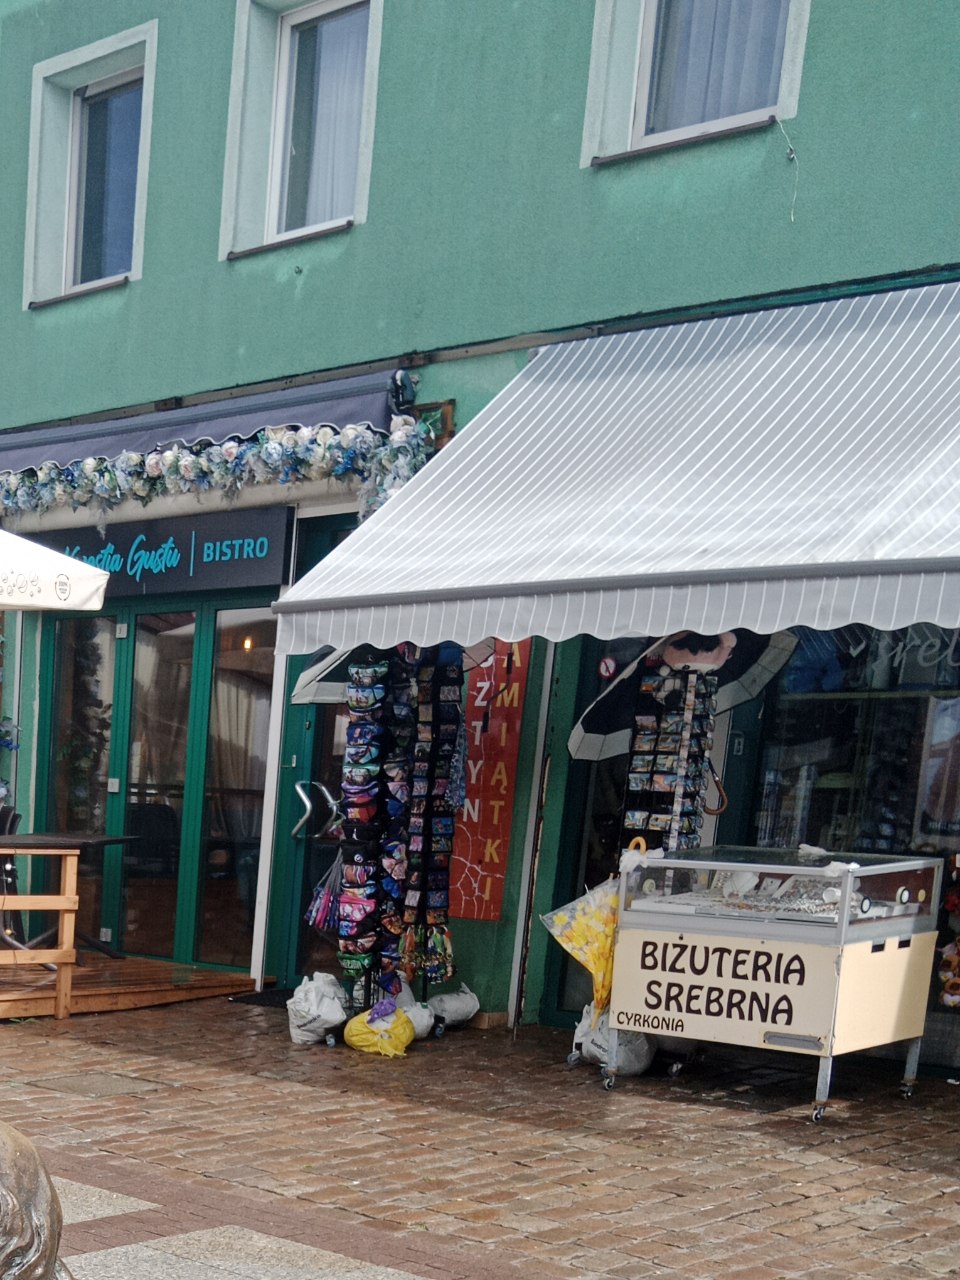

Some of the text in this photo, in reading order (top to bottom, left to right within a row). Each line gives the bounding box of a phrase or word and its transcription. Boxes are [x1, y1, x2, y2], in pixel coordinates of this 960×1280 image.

[127, 534, 180, 582] Gustu
[203, 537, 269, 563] BISTRO
[462, 654, 495, 823] ZTYN
[616, 1011, 684, 1033] CYRKONIA
[644, 980, 793, 1026] SREBRNA
